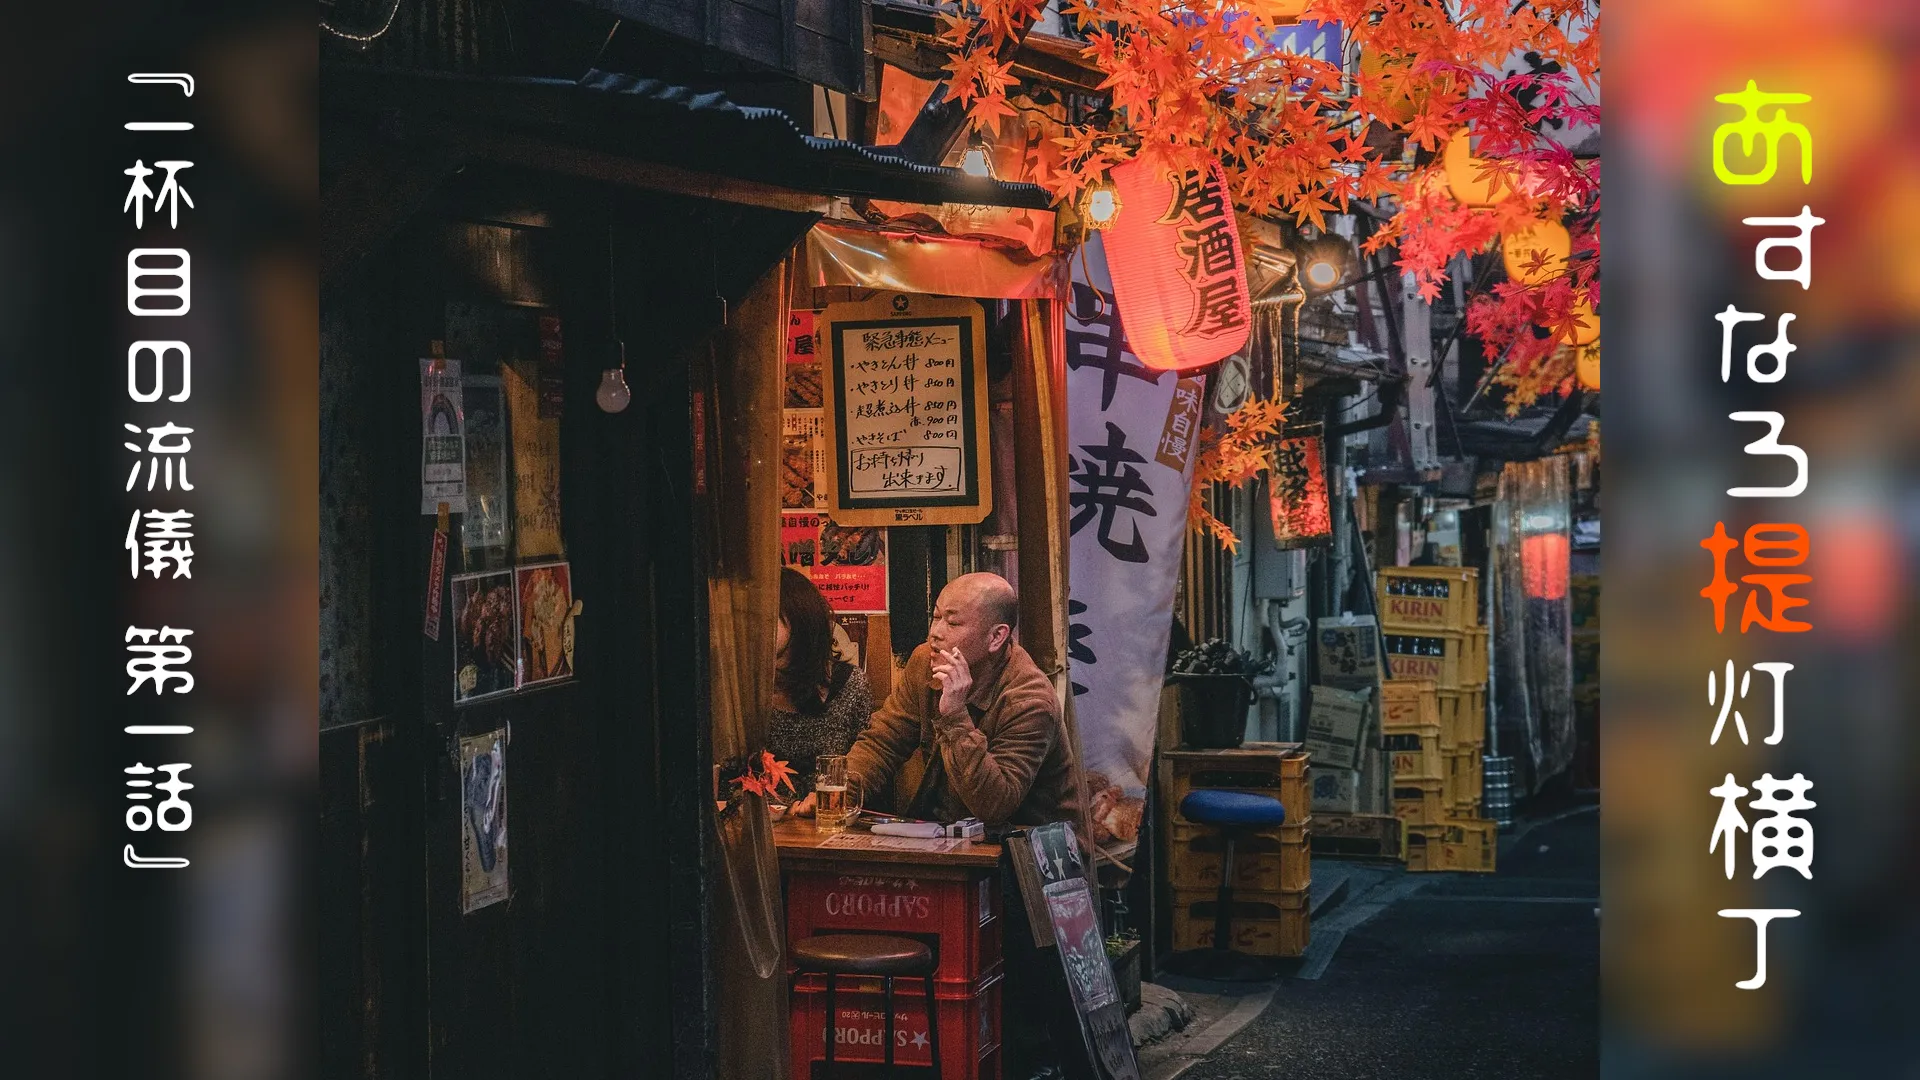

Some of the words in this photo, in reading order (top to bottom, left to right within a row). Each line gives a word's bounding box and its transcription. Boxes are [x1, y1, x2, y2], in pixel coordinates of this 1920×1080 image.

[1156, 165, 1247, 339] 居酒屋
[787, 334, 814, 355] 屋
[924, 358, 955, 368] 800円
[924, 400, 957, 411] 850円
[923, 429, 957, 440] 800円
[1161, 388, 1199, 464] 味自慢
[854, 448, 924, 471] お持ち帰り
[895, 513, 924, 521] 黒ラベル
[1390, 599, 1443, 616] KIRIN
[1391, 658, 1439, 675] KIRIN
[825, 892, 930, 919] SAPPORO
